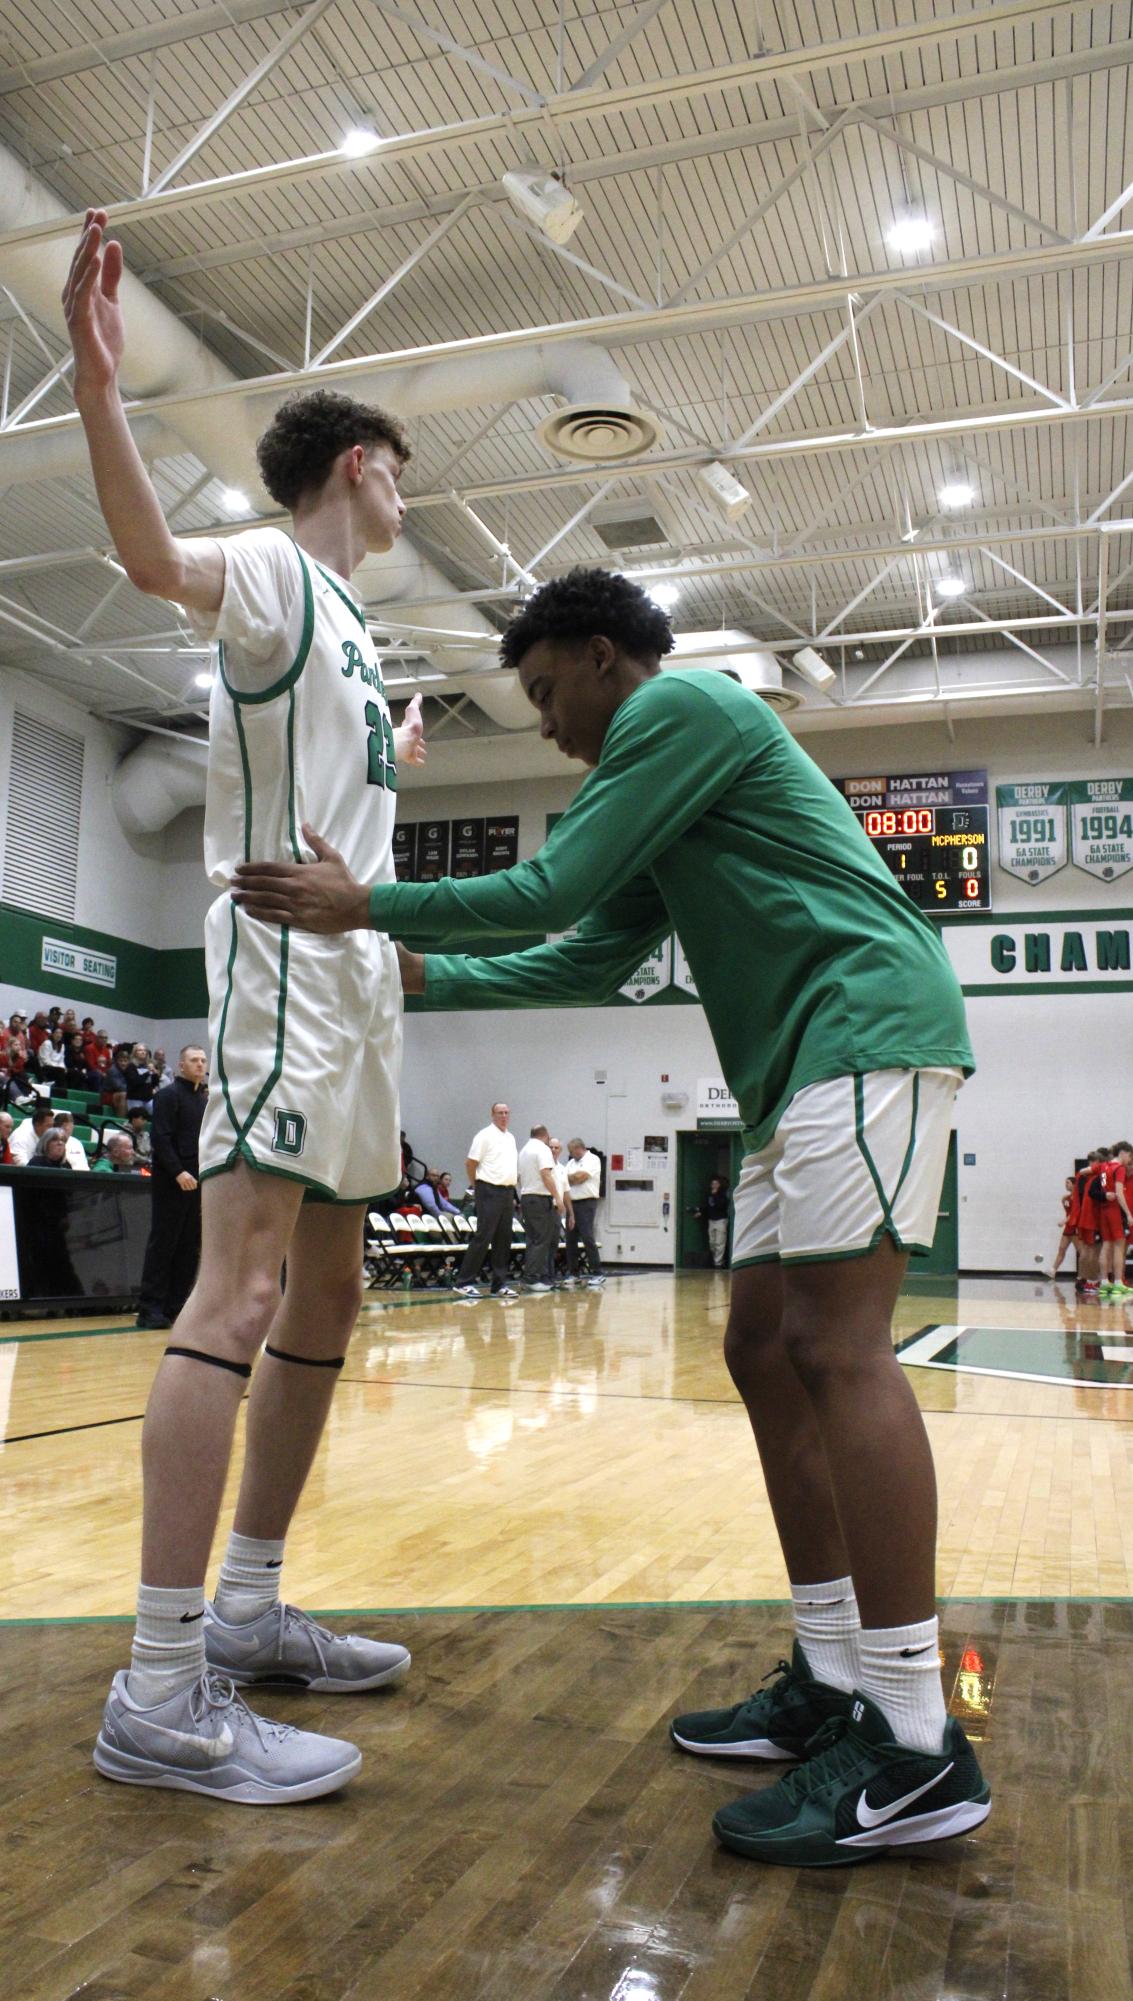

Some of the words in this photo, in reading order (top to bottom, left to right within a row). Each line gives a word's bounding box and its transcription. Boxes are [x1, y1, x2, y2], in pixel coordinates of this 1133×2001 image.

[850, 781, 882, 792] DON
[890, 776, 949, 790] HATTAN
[1014, 785, 1050, 798] DERBY
[1086, 781, 1124, 795] DERBY
[850, 795, 882, 807] DON
[890, 791, 949, 805] HATTAN
[867, 811, 932, 834] 08:00
[1010, 818, 1056, 843] 1991
[1080, 815, 1133, 840] 1994
[887, 843, 912, 851] PERIOD
[931, 833, 985, 846] MCPHERSON
[1028, 847, 1051, 856] STATE
[1102, 843, 1125, 853] STATE
[901, 854, 906, 869] 1
[963, 847, 978, 870] 0
[1011, 857, 1056, 867] CHAMPIONS
[1085, 853, 1131, 864] CHAMPIONS
[958, 871, 982, 879] FOULS
[935, 880, 947, 898] 5
[965, 879, 979, 898] 0
[990, 930, 1131, 974] CHAM
[44, 947, 75, 968] VISITOR
[83, 958, 115, 978] SEATING
[271, 1106, 307, 1158] D
